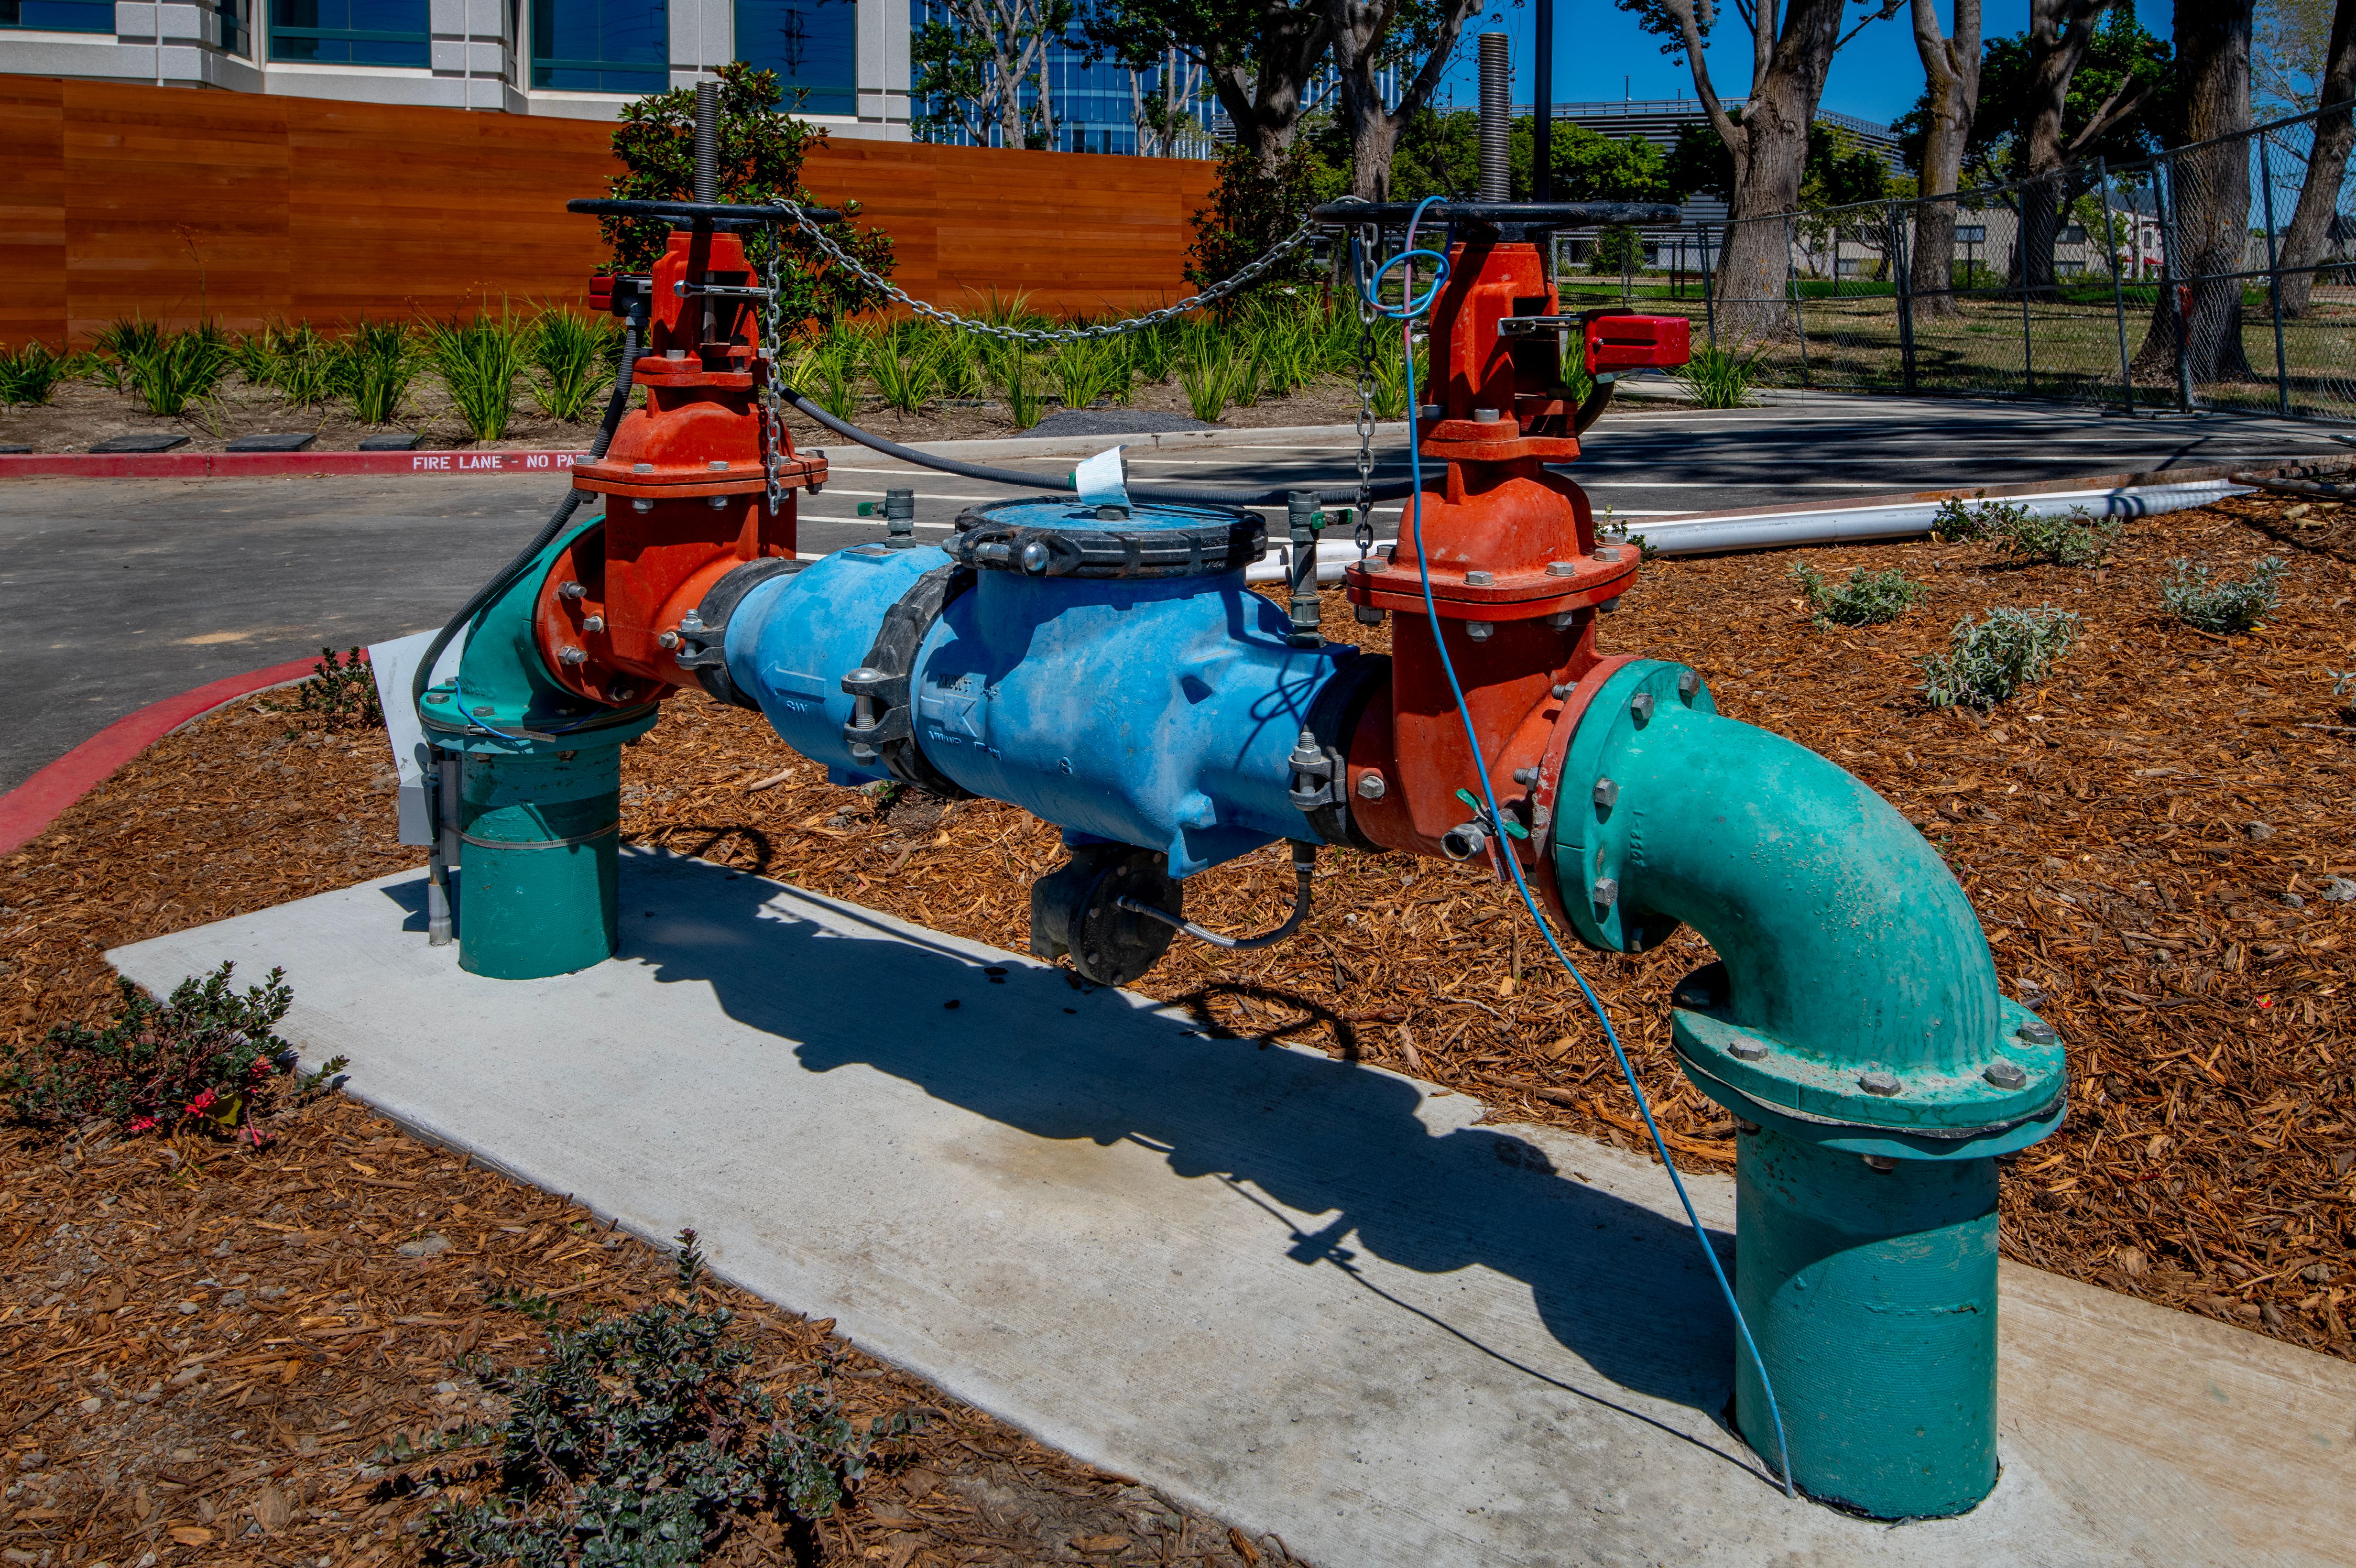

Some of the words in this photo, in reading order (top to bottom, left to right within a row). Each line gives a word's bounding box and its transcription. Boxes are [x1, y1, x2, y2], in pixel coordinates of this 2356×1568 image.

[413, 457, 451, 469] FIRE
[459, 456, 502, 469] LANE
[526, 455, 549, 468] NO
